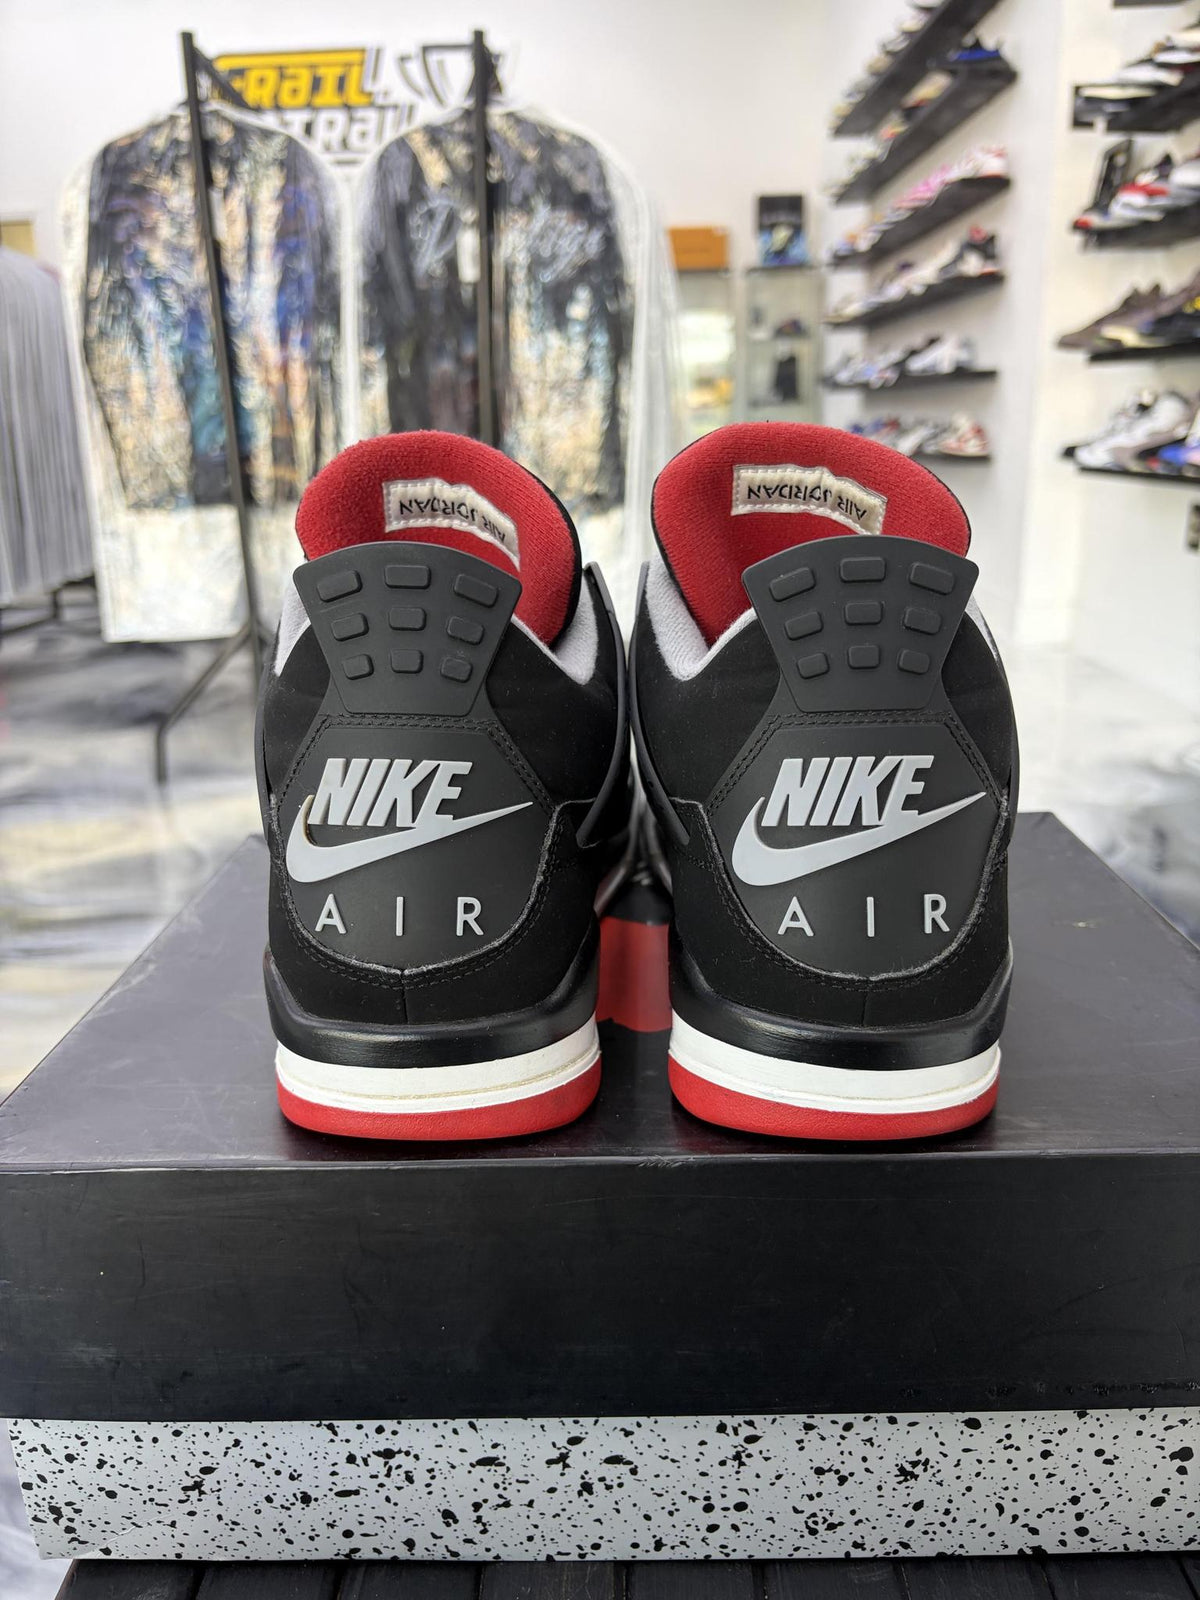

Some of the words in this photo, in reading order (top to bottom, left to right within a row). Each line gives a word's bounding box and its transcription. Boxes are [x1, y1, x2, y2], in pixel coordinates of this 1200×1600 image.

[399, 496, 478, 523] JORDAN
[747, 483, 832, 502] JORDAN
[836, 494, 868, 521] AIR
[481, 514, 506, 543] AIR
[307, 757, 474, 828] NIKE
[761, 754, 936, 827] NIKE
[314, 892, 485, 938] AIR
[777, 892, 951, 938] AIR
